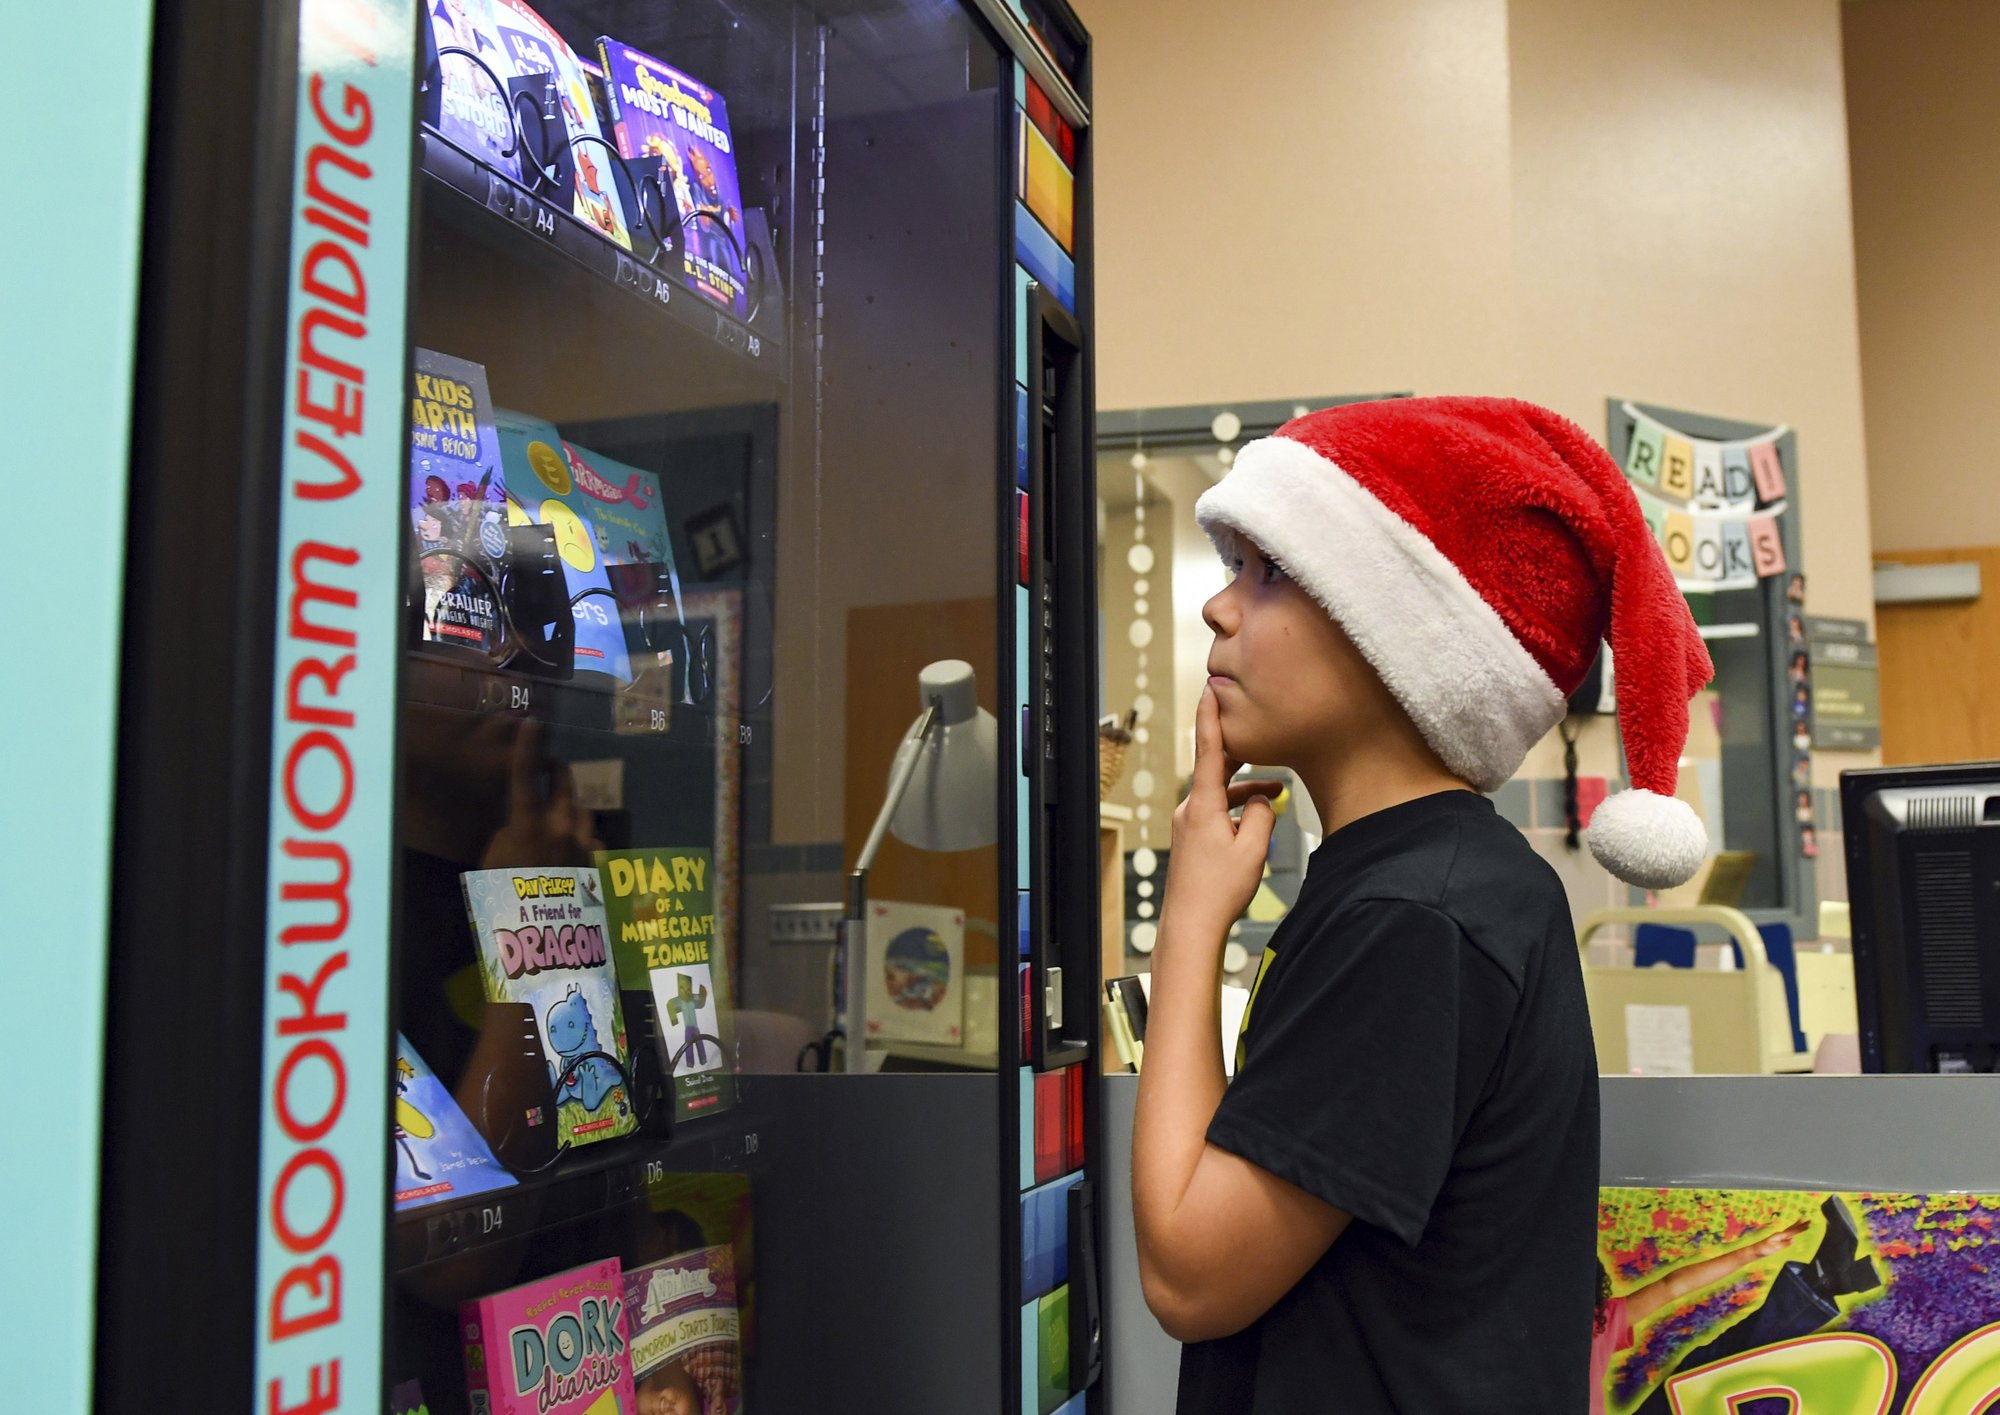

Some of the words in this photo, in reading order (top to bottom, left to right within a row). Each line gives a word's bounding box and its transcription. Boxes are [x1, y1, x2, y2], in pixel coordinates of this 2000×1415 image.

[621, 83, 668, 119] MOST
[671, 103, 730, 154] WANTED
[536, 208, 554, 236] A4
[294, 71, 374, 501] VENDING
[654, 279, 670, 304] A6
[708, 272, 734, 298] STINE
[747, 335, 760, 357] A8
[415, 373, 473, 410] KIDS
[441, 437, 477, 459] BEYOND
[1650, 525, 1776, 573] OOKS
[440, 591, 492, 618] BRALLIER
[571, 600, 608, 626] ers
[511, 685, 529, 710] B4
[650, 709, 666, 731] B6
[740, 725, 753, 745] B8
[608, 856, 706, 897] DIARY
[520, 906, 528, 922] A
[532, 904, 565, 922] Friend
[568, 903, 582, 920] for
[656, 898, 671, 914] OF
[675, 897, 684, 912] A
[268, 538, 361, 1343] BOOKWORM
[621, 915, 715, 943] MINECRAFT
[494, 924, 606, 979] DRAGON
[643, 941, 709, 968] ZOMBIE
[745, 1134, 759, 1154] D8
[647, 1161, 663, 1184] D6
[482, 1205, 503, 1234] D4
[511, 1298, 624, 1394] DORK
[632, 1330, 676, 1369] TOMORROW
[678, 1318, 709, 1341] STARTS
[538, 1359, 622, 1414] diaries
